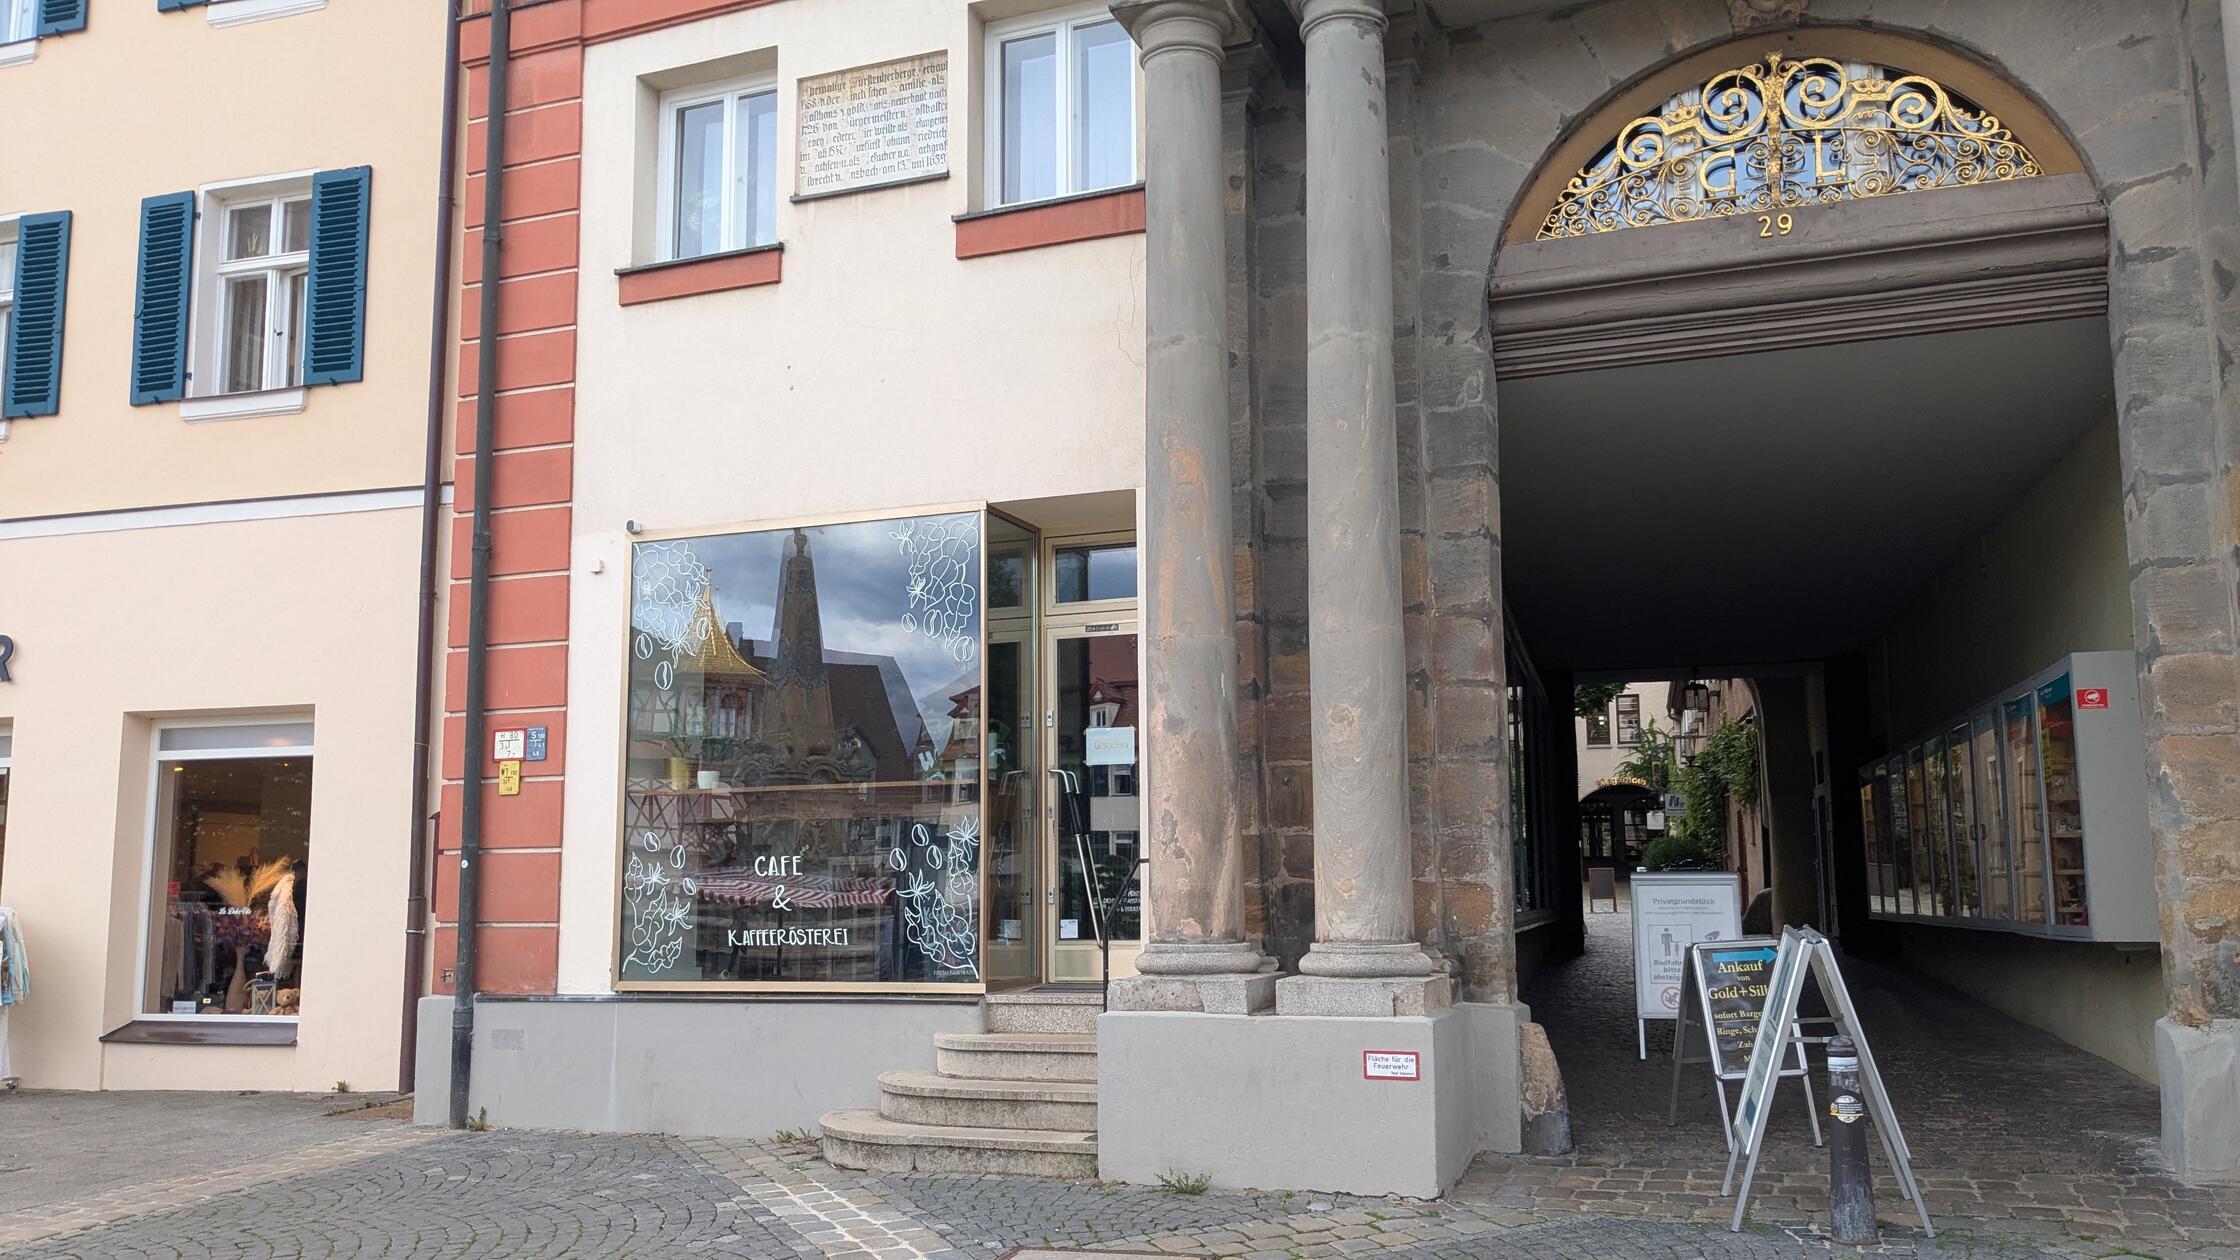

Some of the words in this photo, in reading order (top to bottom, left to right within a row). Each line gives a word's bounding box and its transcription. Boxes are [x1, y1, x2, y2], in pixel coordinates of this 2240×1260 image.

[802, 82, 847, 97] hemalige
[846, 110, 900, 128] ürgermeister
[1757, 213, 1793, 238] 29
[772, 884, 793, 912] &
[1718, 960, 1763, 973] Ankauf
[1714, 1011, 1738, 1019] sofort
[1742, 1026, 1759, 1034] Sch
